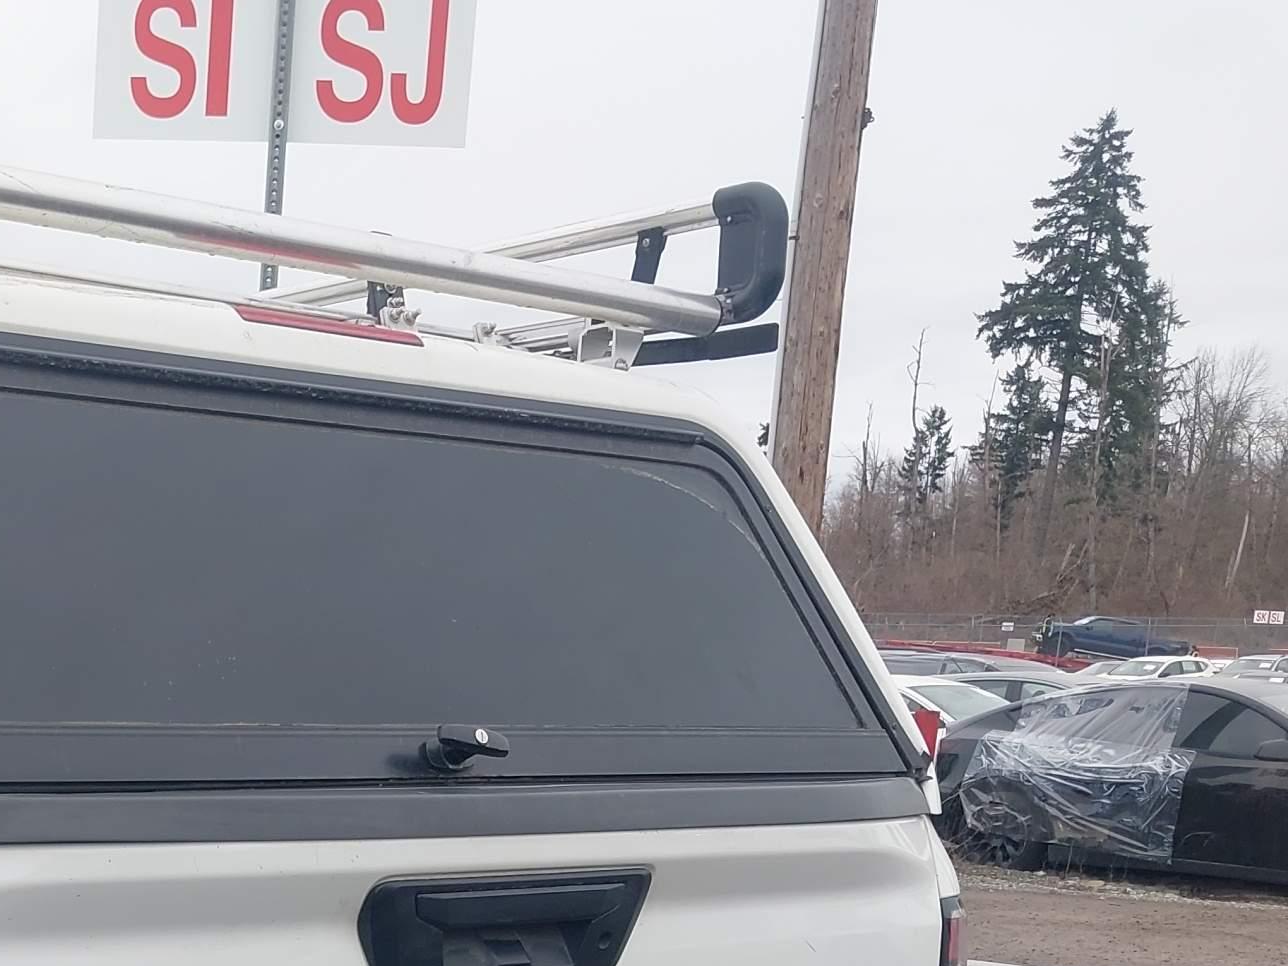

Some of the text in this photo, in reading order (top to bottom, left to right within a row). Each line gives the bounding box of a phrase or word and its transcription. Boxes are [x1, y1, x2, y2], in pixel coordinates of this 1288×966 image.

[130, 0, 235, 119] SI
[315, 0, 450, 125] SJ
[1271, 612, 1281, 622] SL
